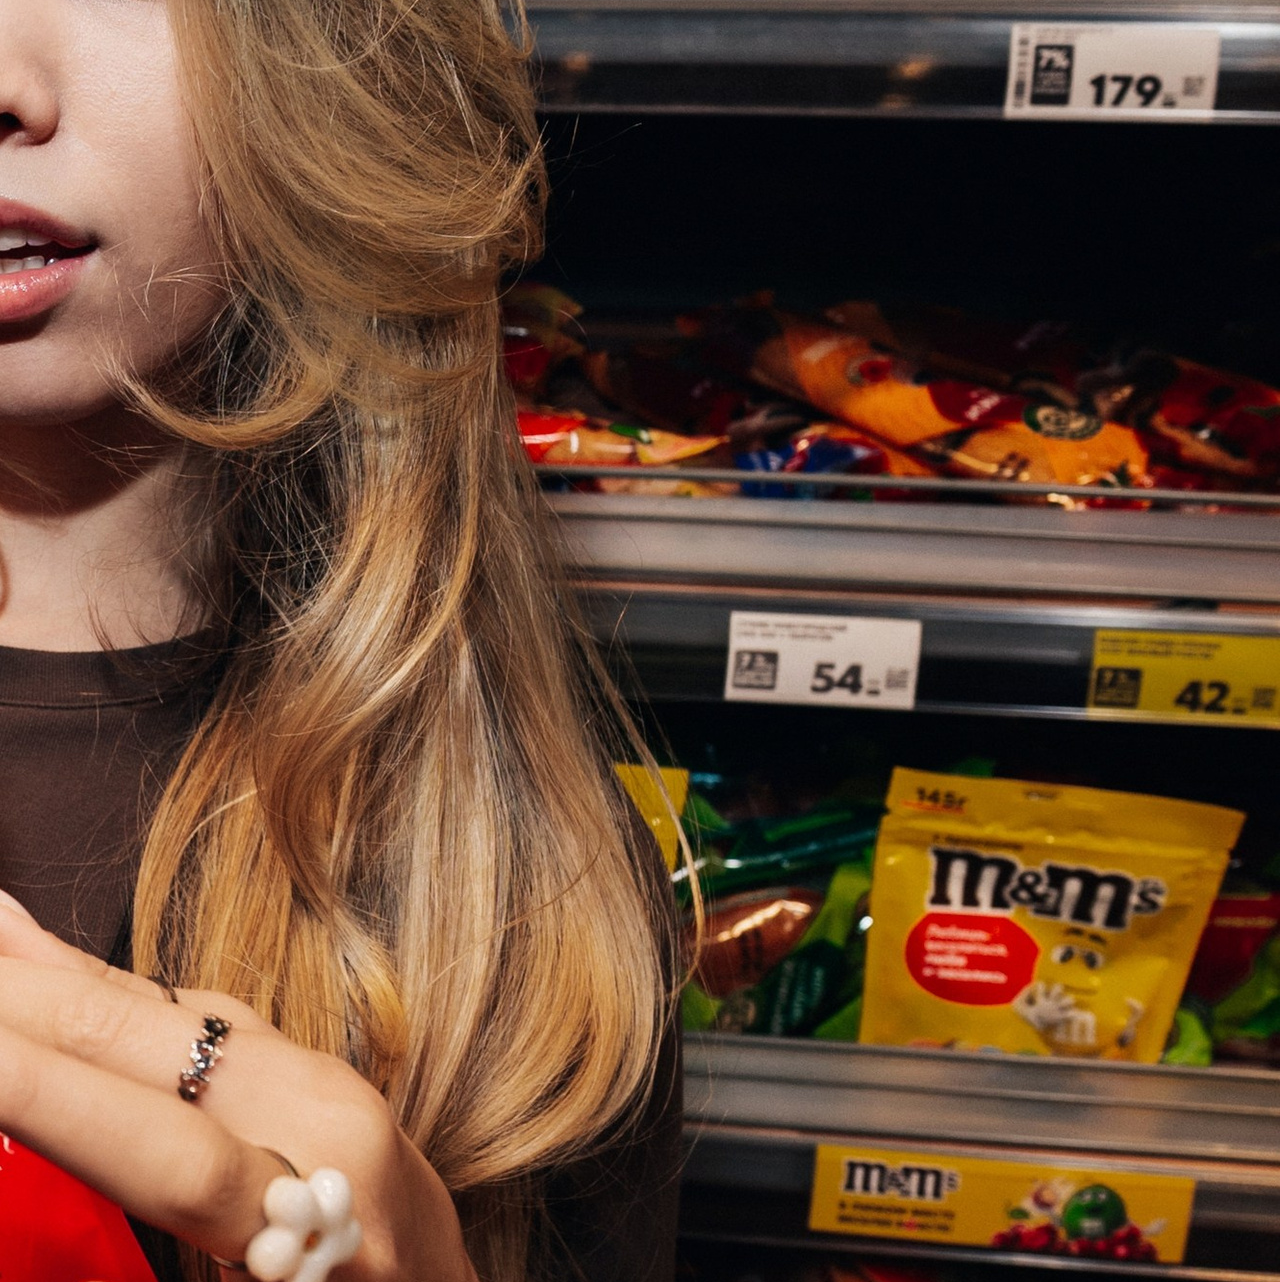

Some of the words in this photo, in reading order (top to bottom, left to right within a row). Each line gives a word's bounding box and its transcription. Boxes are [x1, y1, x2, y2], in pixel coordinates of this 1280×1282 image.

[1090, 74, 1162, 107] 179
[810, 661, 864, 695] 54
[1175, 679, 1230, 714] 42
